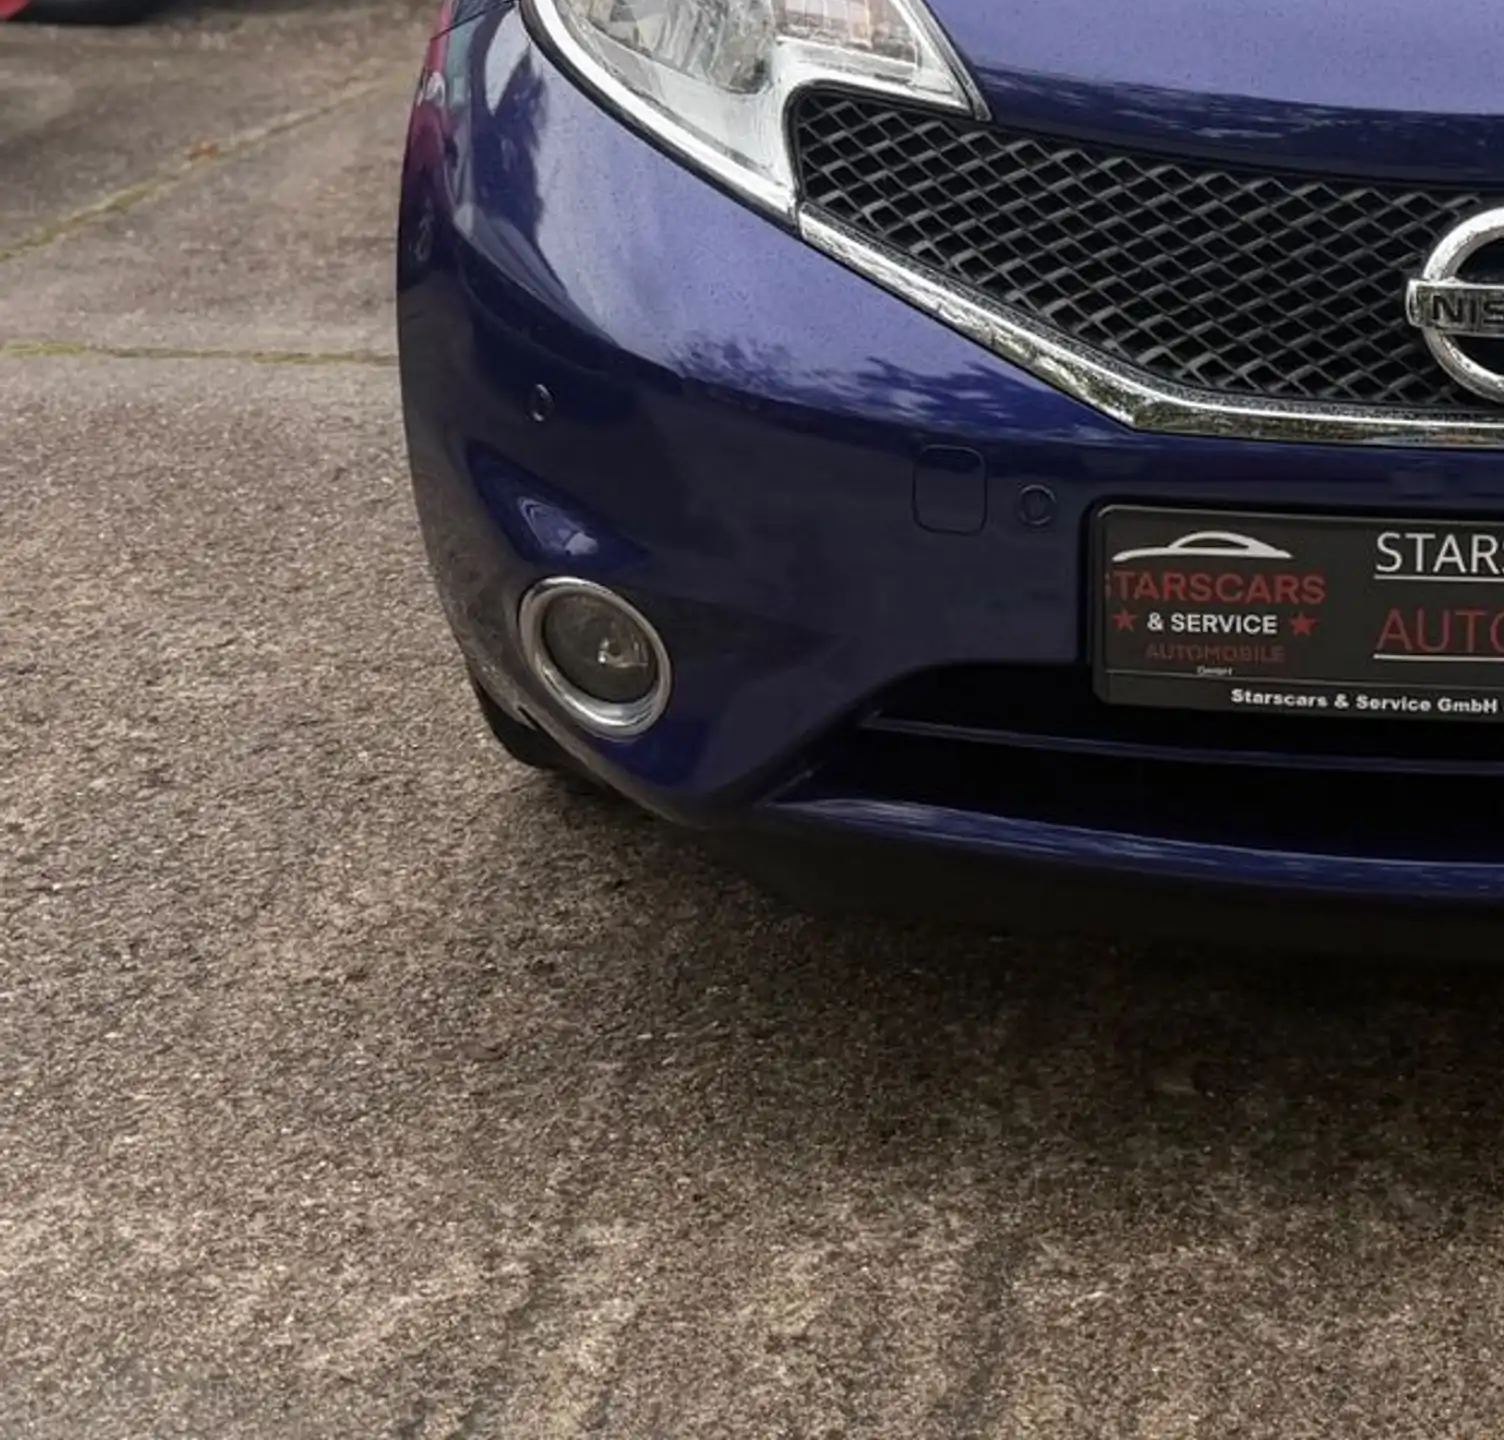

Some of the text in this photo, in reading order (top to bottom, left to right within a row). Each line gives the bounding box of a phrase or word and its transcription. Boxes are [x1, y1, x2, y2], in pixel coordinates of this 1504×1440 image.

[1147, 612, 1278, 634] & SERVICE
[1146, 642, 1286, 664] AUTOMOBILE
[1231, 688, 1328, 708] Starscars
[1334, 693, 1349, 709] &
[1356, 694, 1431, 711] Service
[1437, 697, 1498, 714] GmbH
